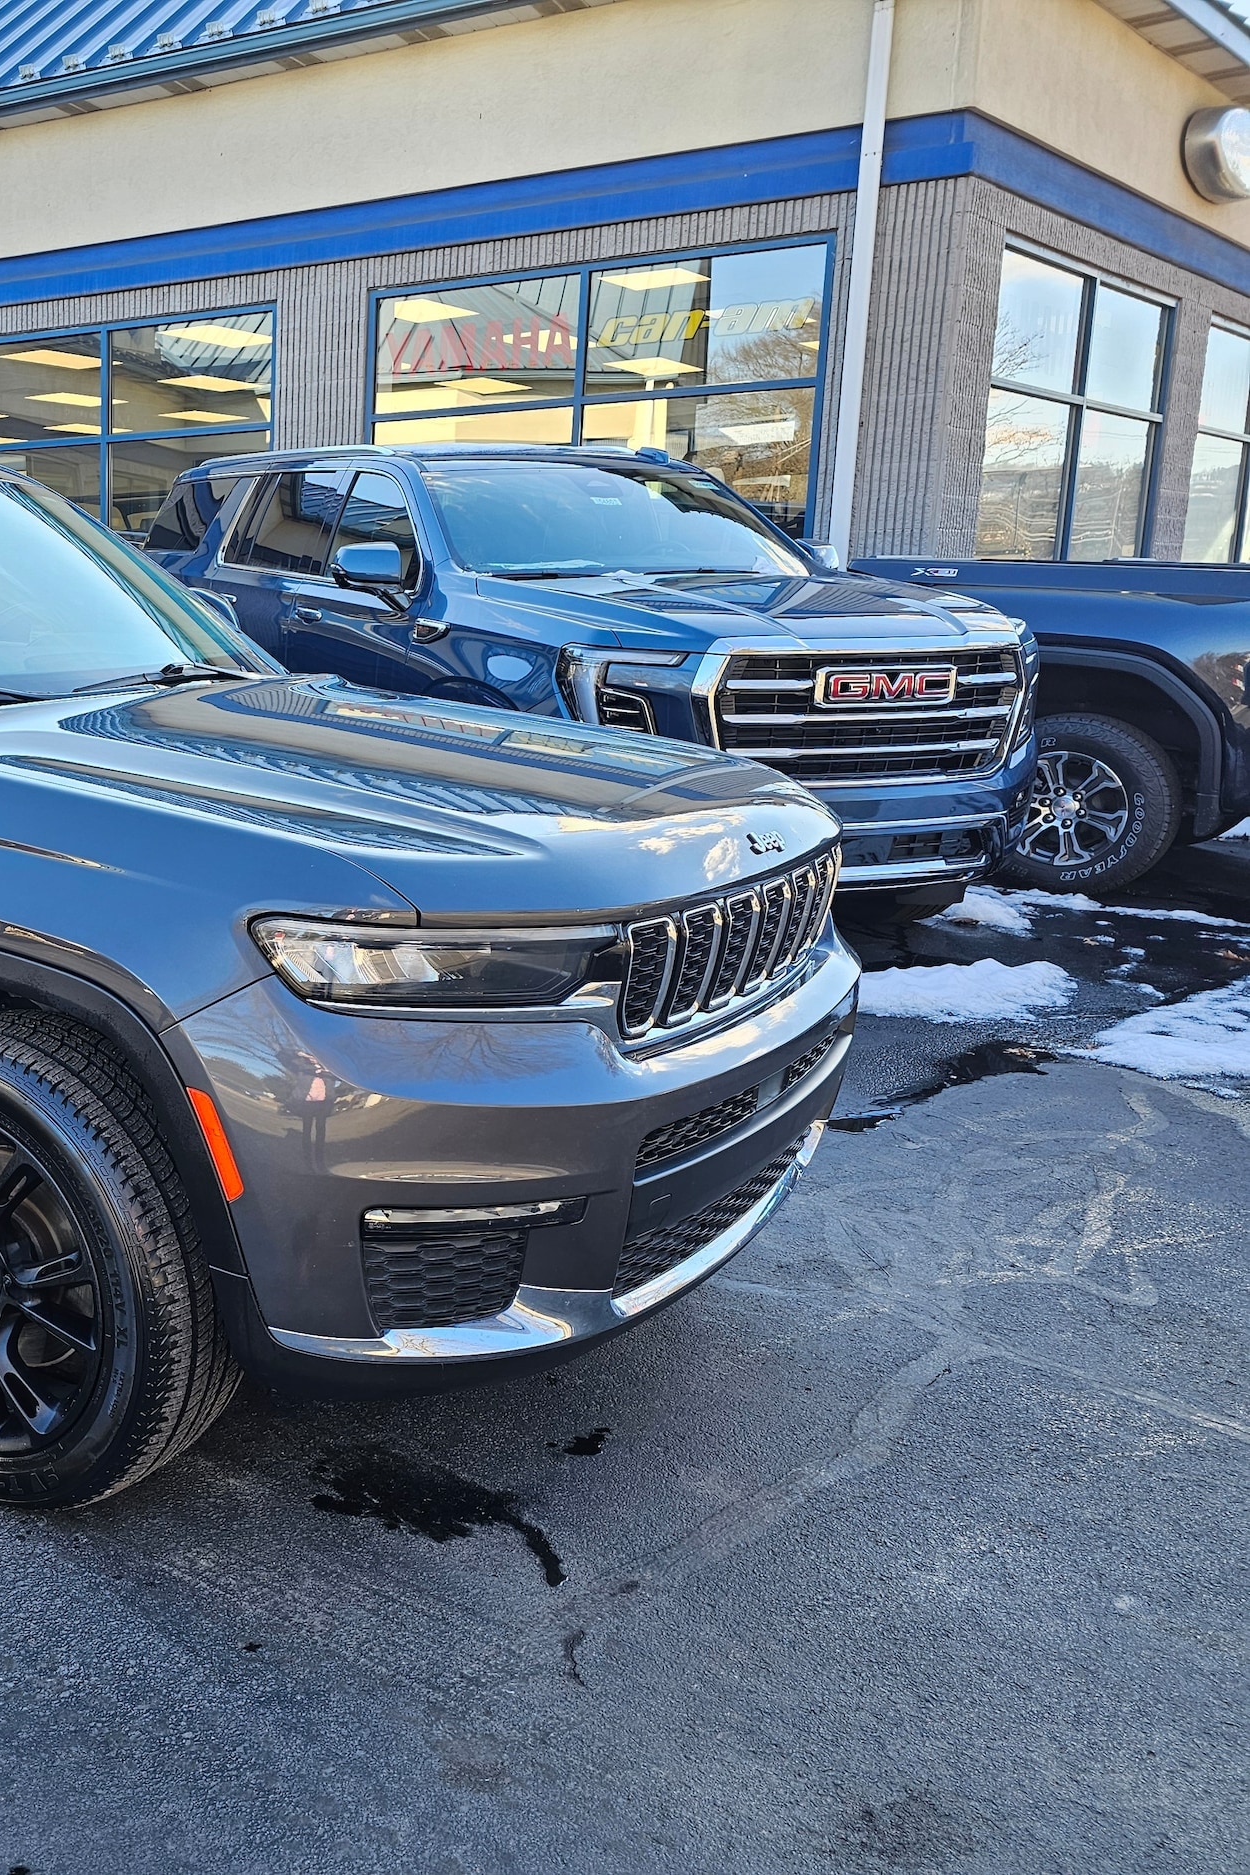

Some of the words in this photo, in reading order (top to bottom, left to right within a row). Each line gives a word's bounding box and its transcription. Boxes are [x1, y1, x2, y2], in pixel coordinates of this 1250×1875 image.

[386, 312, 573, 378] YAMAHA
[597, 296, 816, 348] can-am
[828, 672, 952, 700] GMC
[1060, 792, 1146, 881] GOODYEAR
